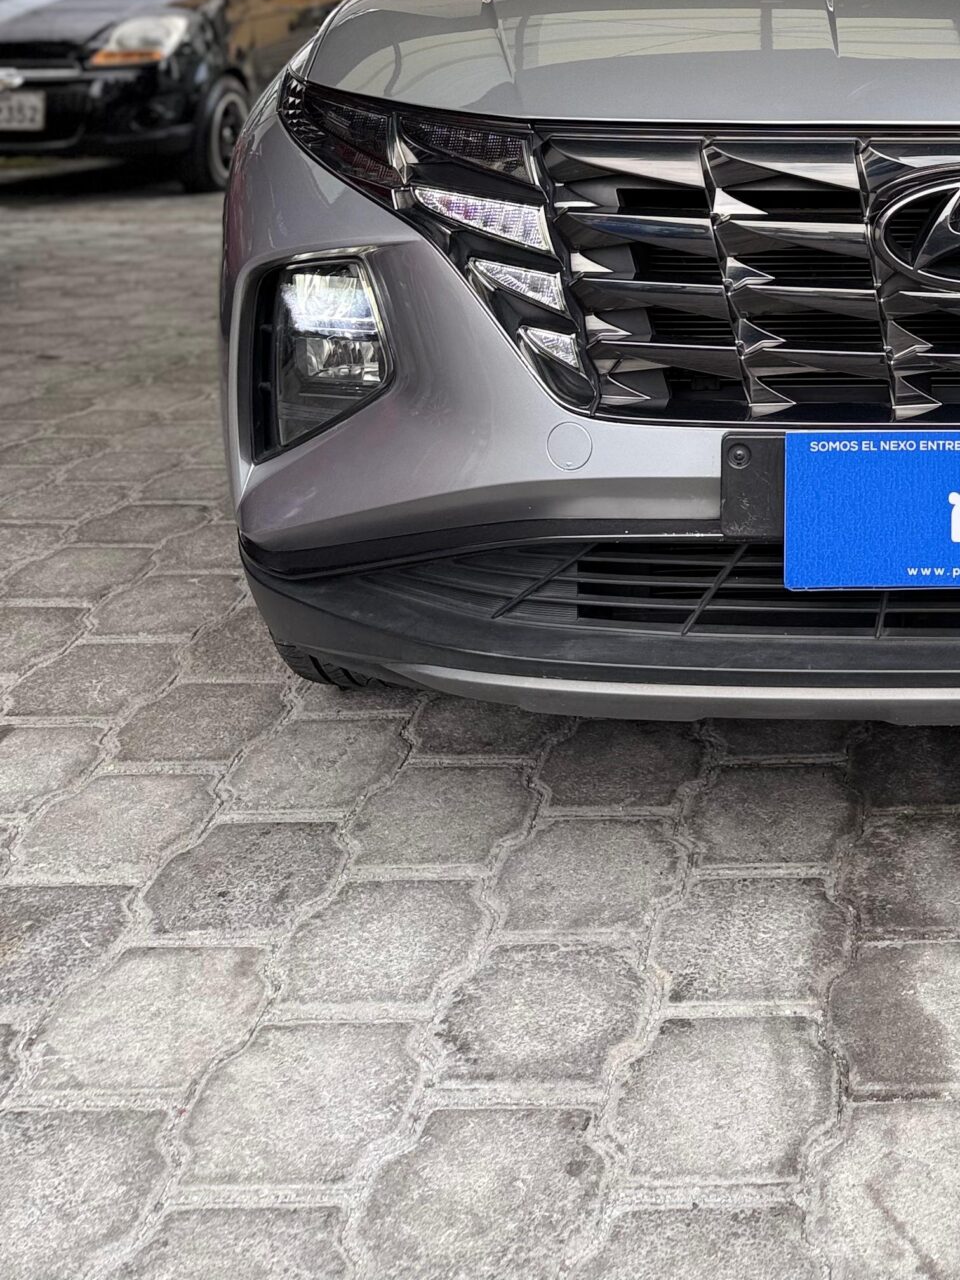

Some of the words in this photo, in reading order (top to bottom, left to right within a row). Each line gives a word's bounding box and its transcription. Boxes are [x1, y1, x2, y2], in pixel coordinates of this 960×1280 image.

[810, 441, 859, 452] SOMOS
[861, 441, 877, 451] EL
[880, 440, 916, 451] NEXO
